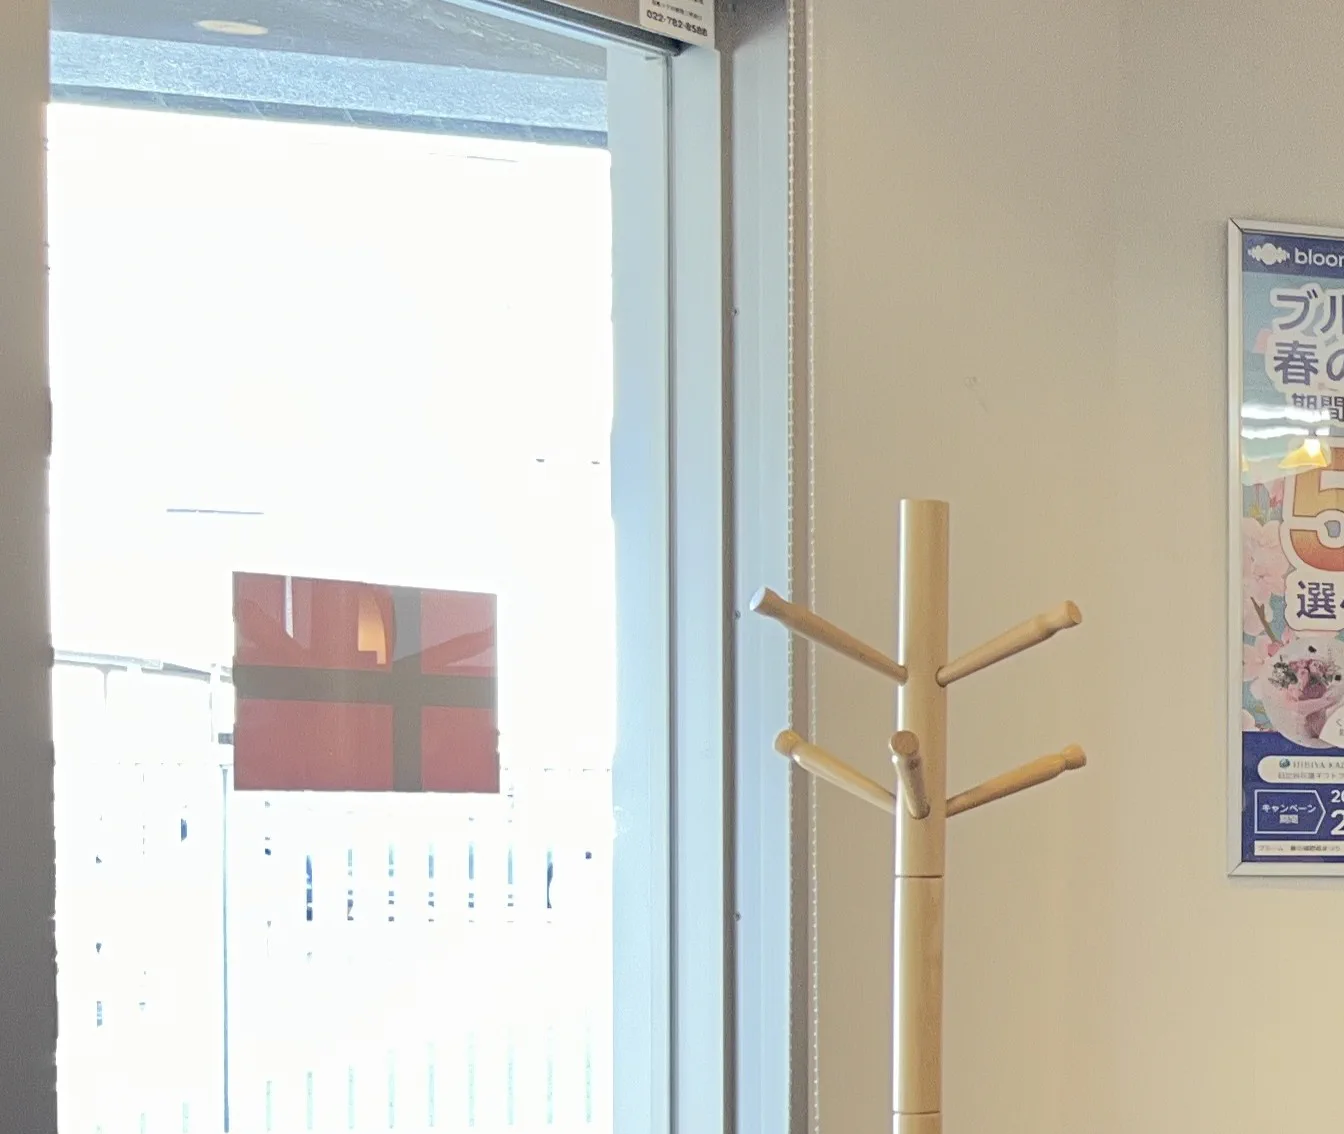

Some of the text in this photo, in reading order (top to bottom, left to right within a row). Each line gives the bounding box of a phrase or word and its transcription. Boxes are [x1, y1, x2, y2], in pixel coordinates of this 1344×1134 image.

[1261, 804, 1317, 814] キャンペーン
